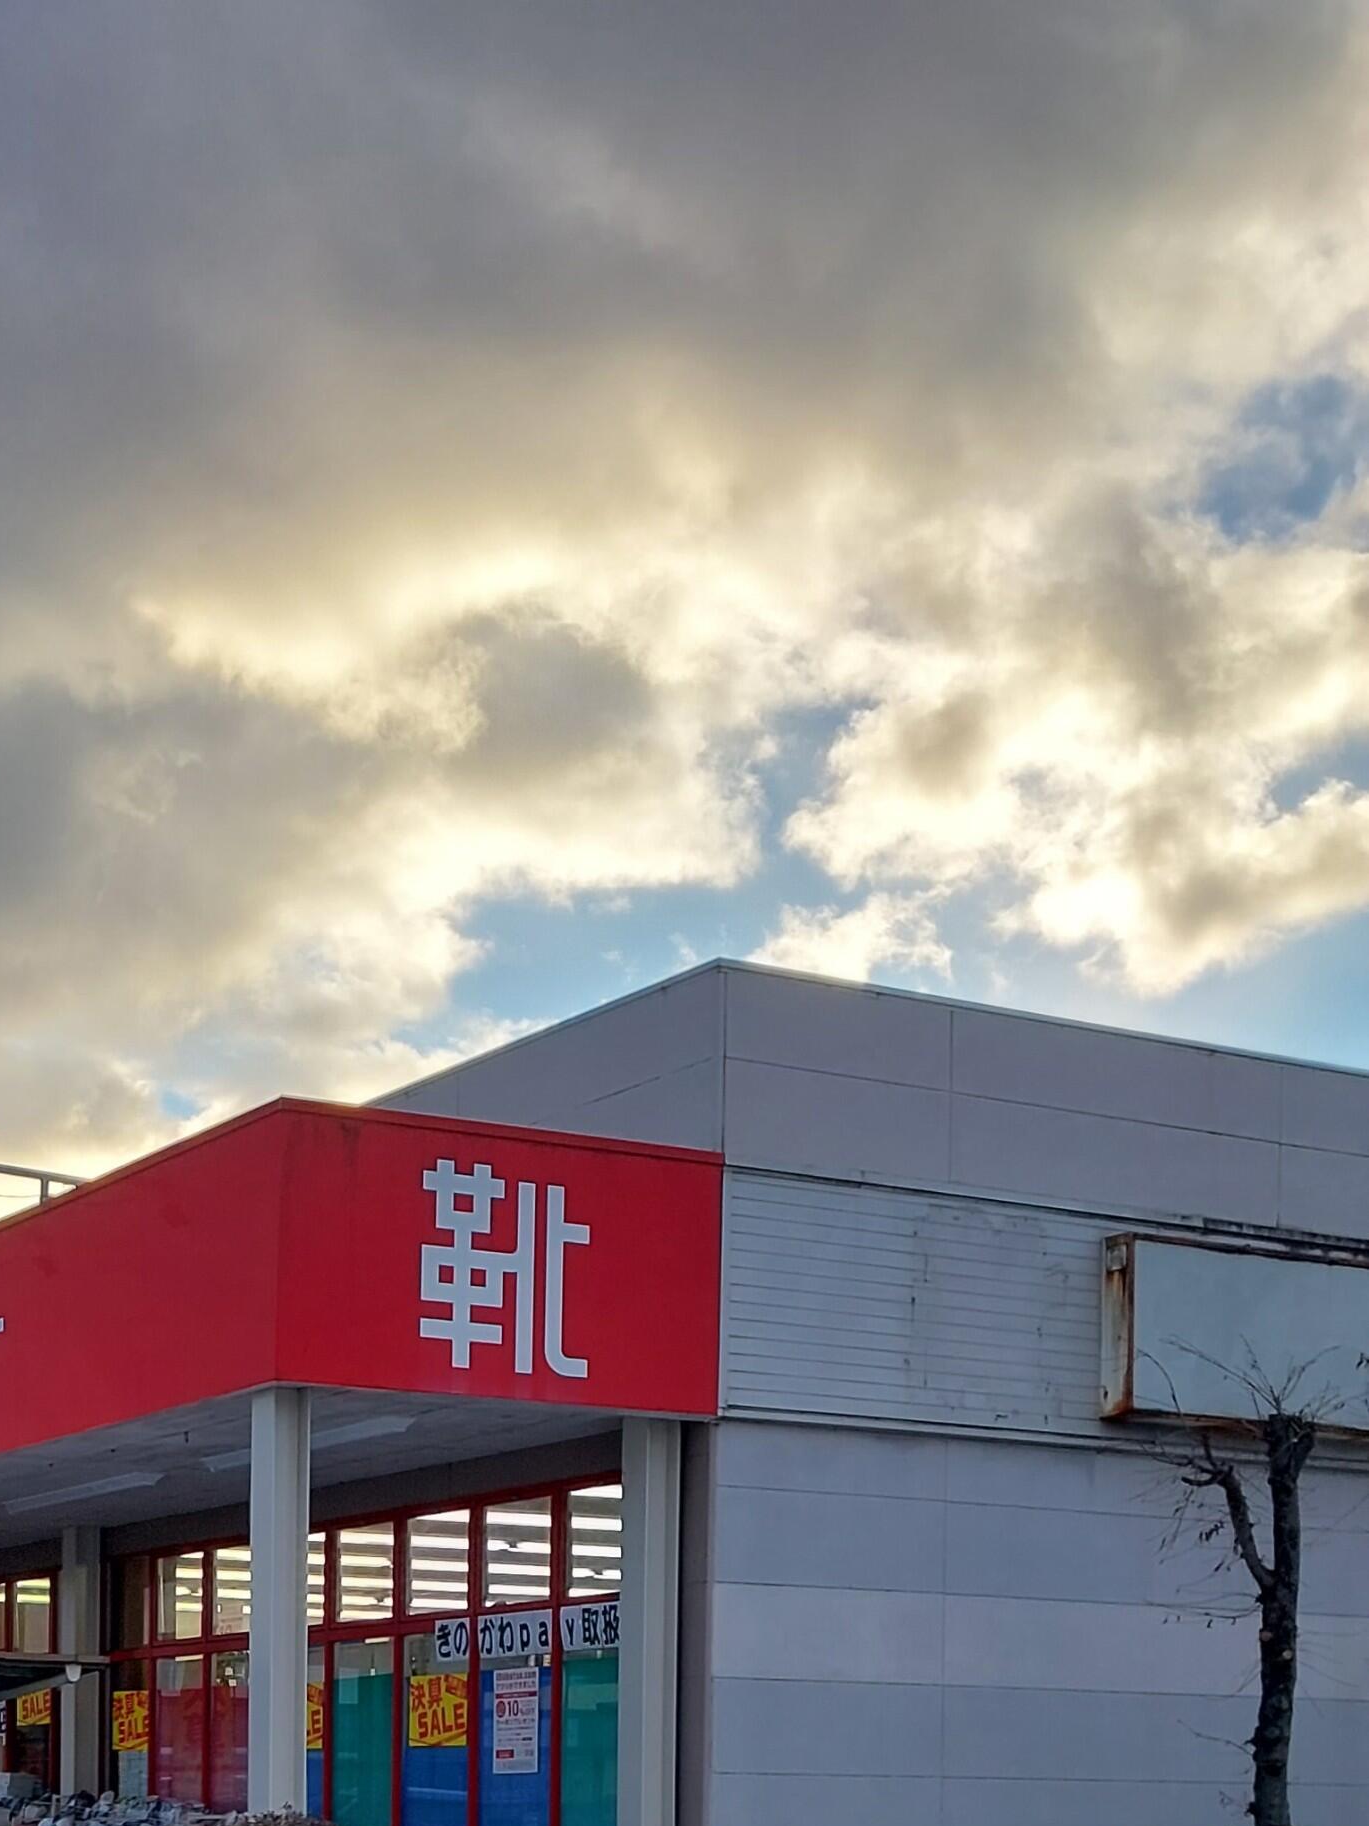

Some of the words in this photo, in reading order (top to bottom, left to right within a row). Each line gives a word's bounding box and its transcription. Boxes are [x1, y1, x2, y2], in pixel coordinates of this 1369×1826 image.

[419, 1158, 591, 1379] 靴
[418, 1702, 466, 1739] SALE
[507, 1699, 519, 1717] 10
